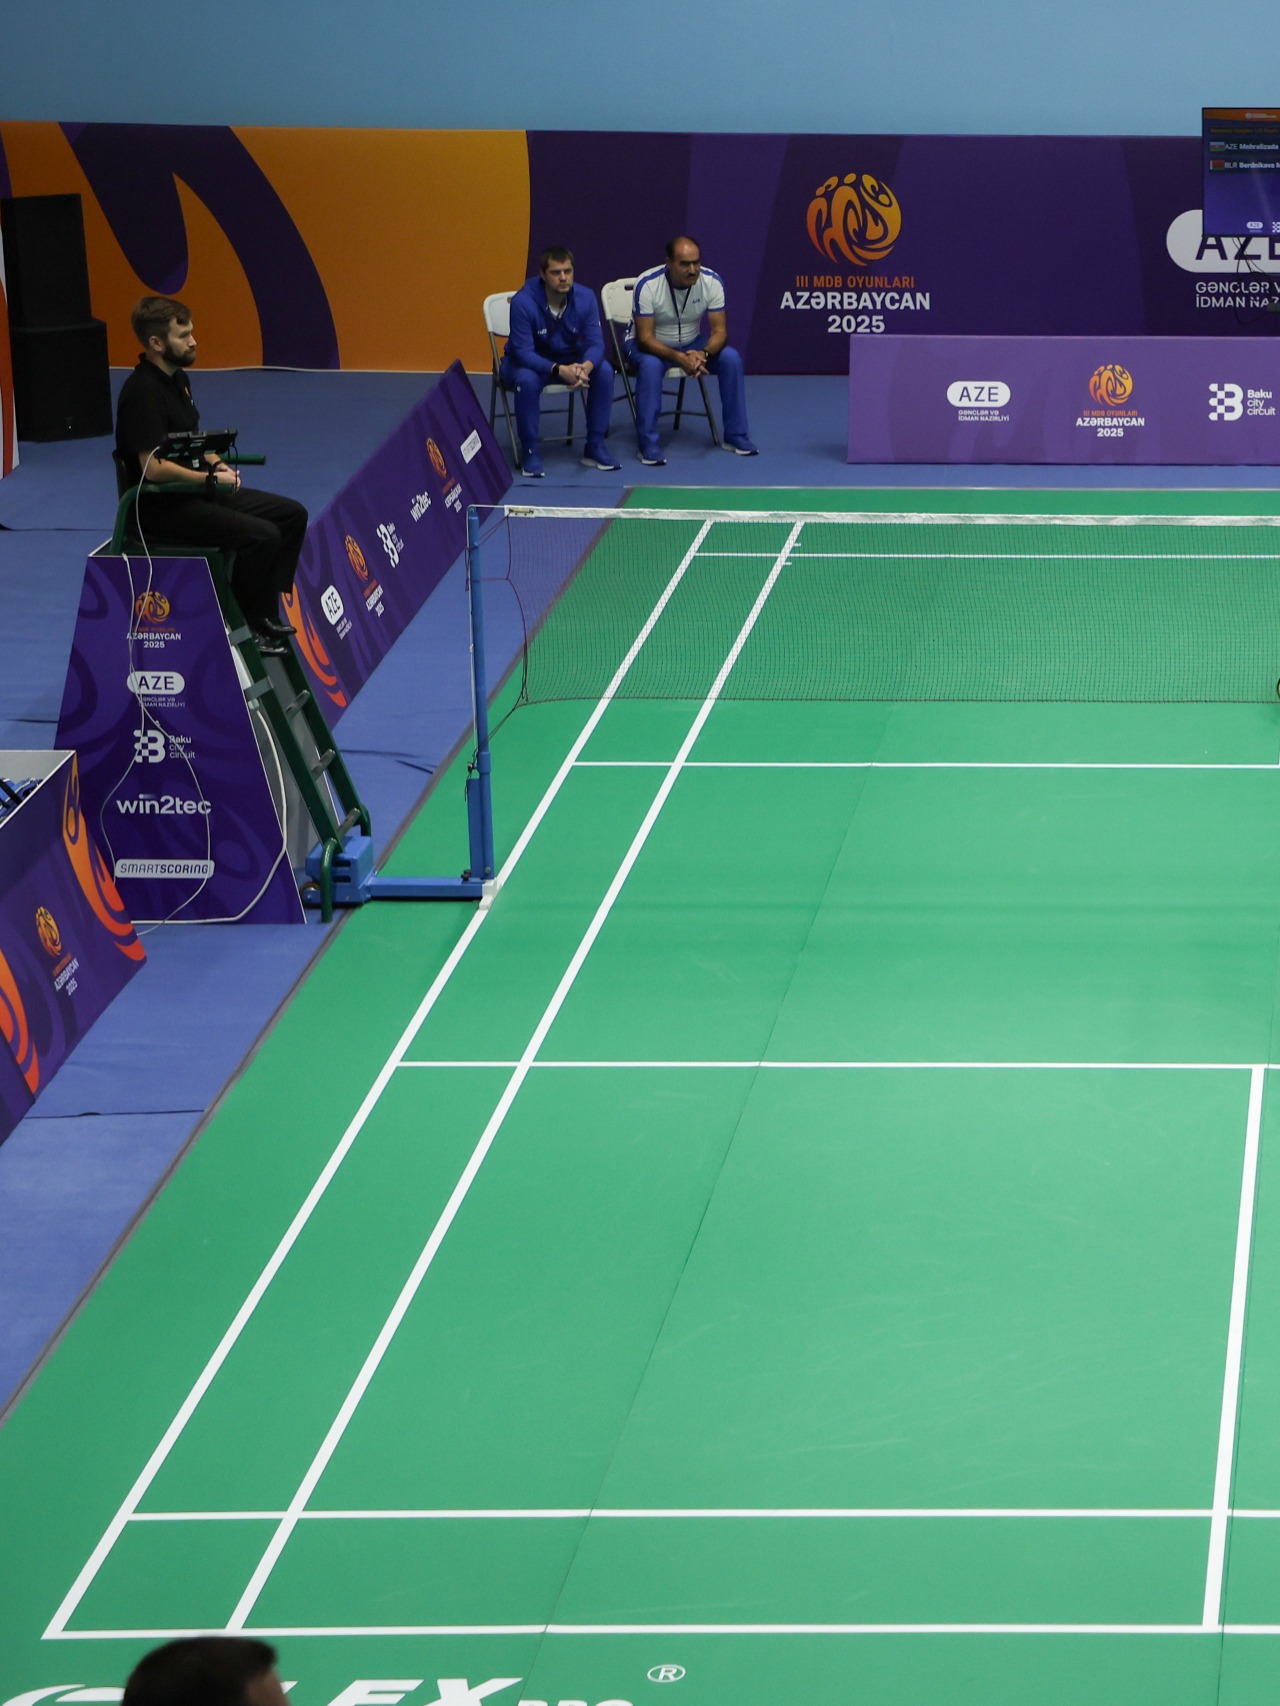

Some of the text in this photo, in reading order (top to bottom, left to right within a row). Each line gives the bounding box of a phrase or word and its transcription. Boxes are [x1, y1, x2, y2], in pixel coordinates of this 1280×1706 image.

[796, 275, 915, 288] III MDB OYUNLARI
[780, 291, 930, 310] AZƏRBAYCAN
[1195, 293, 1245, 308] İDMAN
[827, 314, 885, 333] 2025
[959, 386, 998, 402] AZE
[1247, 388, 1272, 398] Baku
[1247, 398, 1265, 408] city
[1247, 406, 1276, 416] circuit
[1075, 417, 1145, 426] AZƏRBAYCAN
[1096, 427, 1124, 437] 2025
[325, 591, 340, 619] AZE
[127, 632, 182, 640] AZƏRBAYCAN
[138, 675, 174, 690] AZE
[116, 793, 212, 814] win2tec
[120, 863, 209, 874] SMARTSCORING
